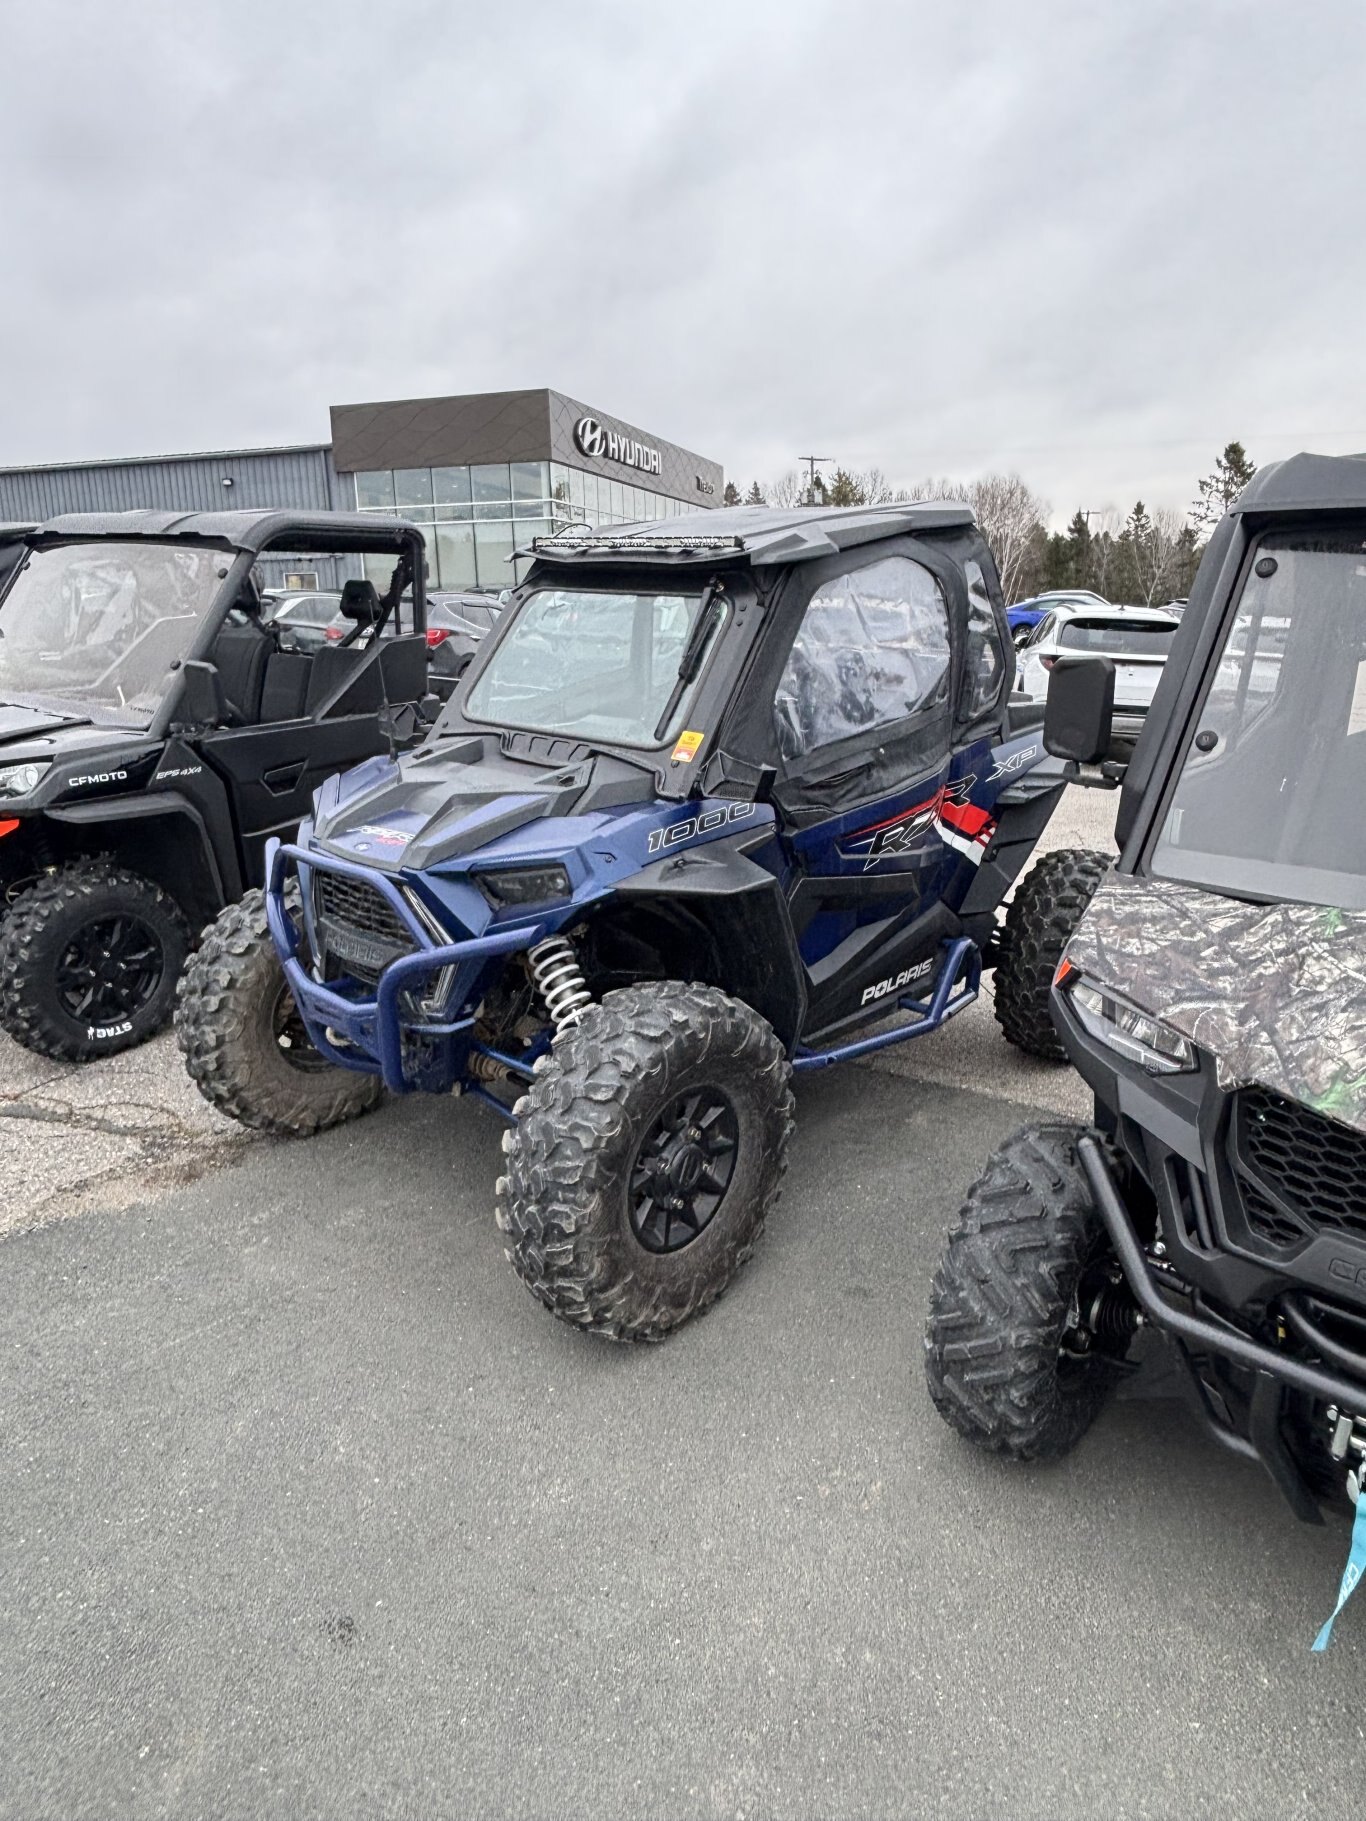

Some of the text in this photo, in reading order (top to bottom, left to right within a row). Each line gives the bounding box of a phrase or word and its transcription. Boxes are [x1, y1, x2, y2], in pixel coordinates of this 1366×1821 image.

[607, 431, 662, 475] HYUNDAI
[68, 770, 128, 788] CFMOTO
[156, 768, 180, 780] EPS
[985, 745, 1037, 782] XP
[648, 801, 756, 853] 1000
[860, 957, 934, 1006] POLARIS
[96, 1021, 133, 1039] STAG
